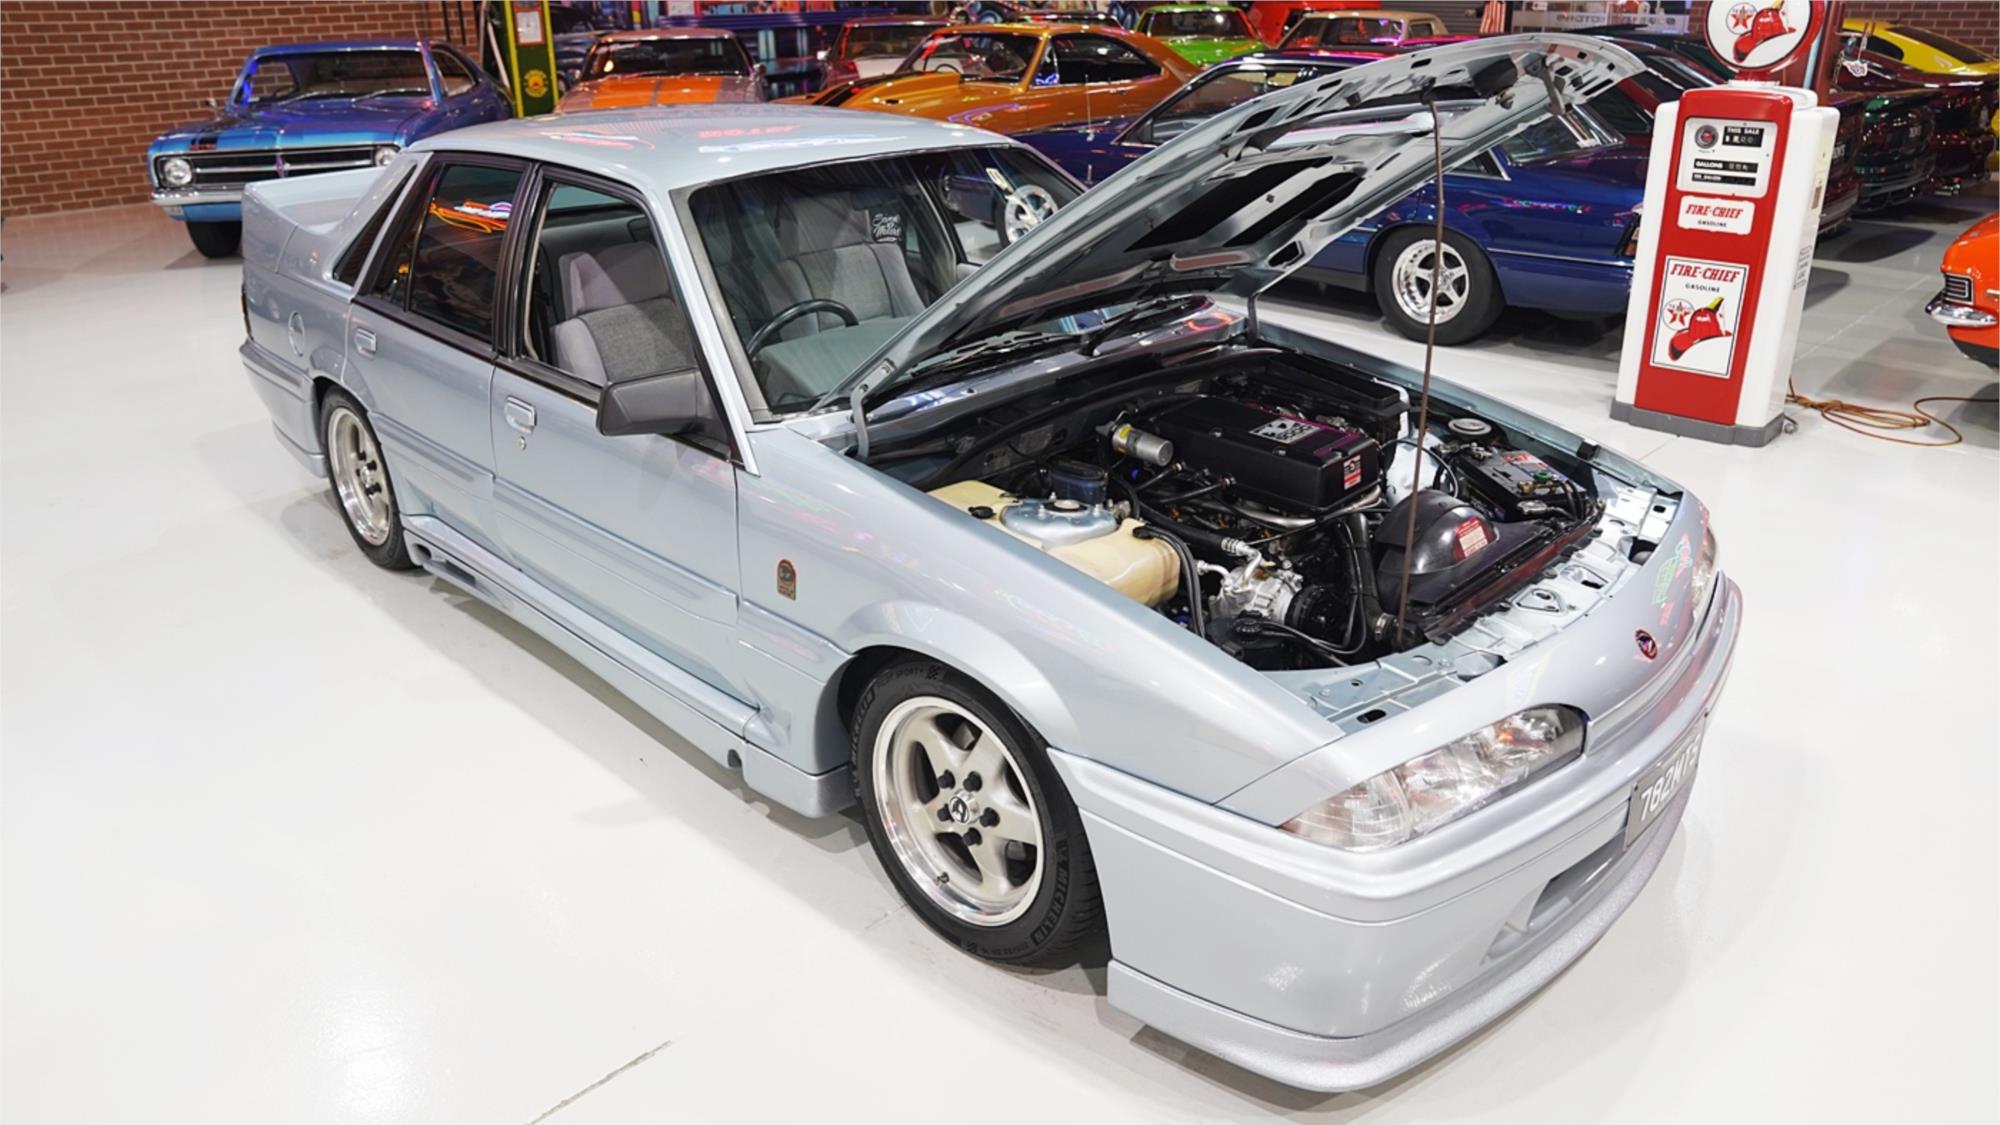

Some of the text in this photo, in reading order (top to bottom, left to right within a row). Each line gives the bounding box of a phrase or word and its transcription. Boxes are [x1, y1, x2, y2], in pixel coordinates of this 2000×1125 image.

[1698, 220, 1727, 228] GASOLINE
[1685, 283, 1720, 293] GASOLINE
[1033, 867, 1068, 941] MICHELIN
